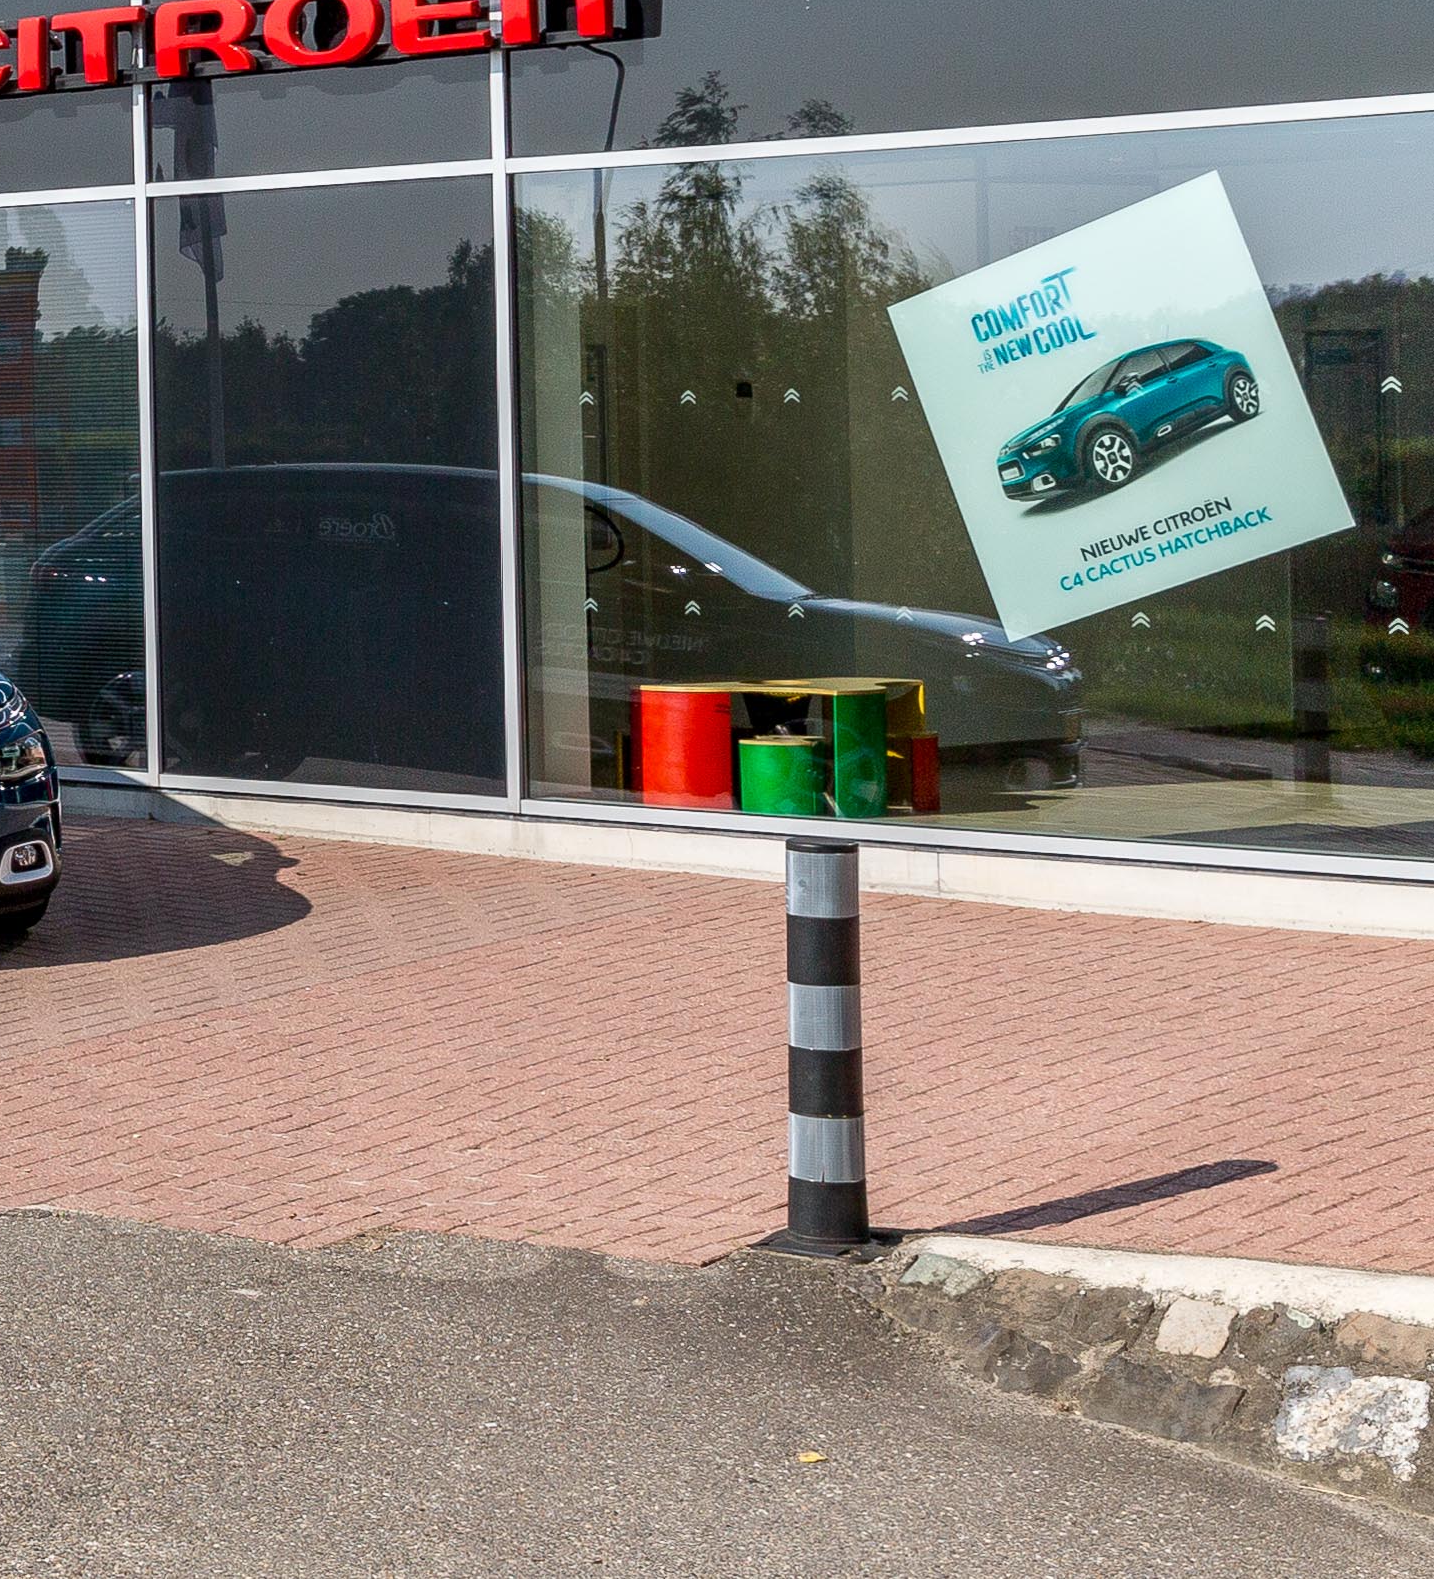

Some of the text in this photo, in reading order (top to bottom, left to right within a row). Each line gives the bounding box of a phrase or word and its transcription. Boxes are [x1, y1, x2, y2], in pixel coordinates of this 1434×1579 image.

[971, 266, 1078, 343] COMFORT
[993, 316, 1097, 366] NEW COOL
[1059, 506, 1273, 591] C4 CACTUS HATCHBACK
[1080, 496, 1233, 562] NIEUWE CITROËN
